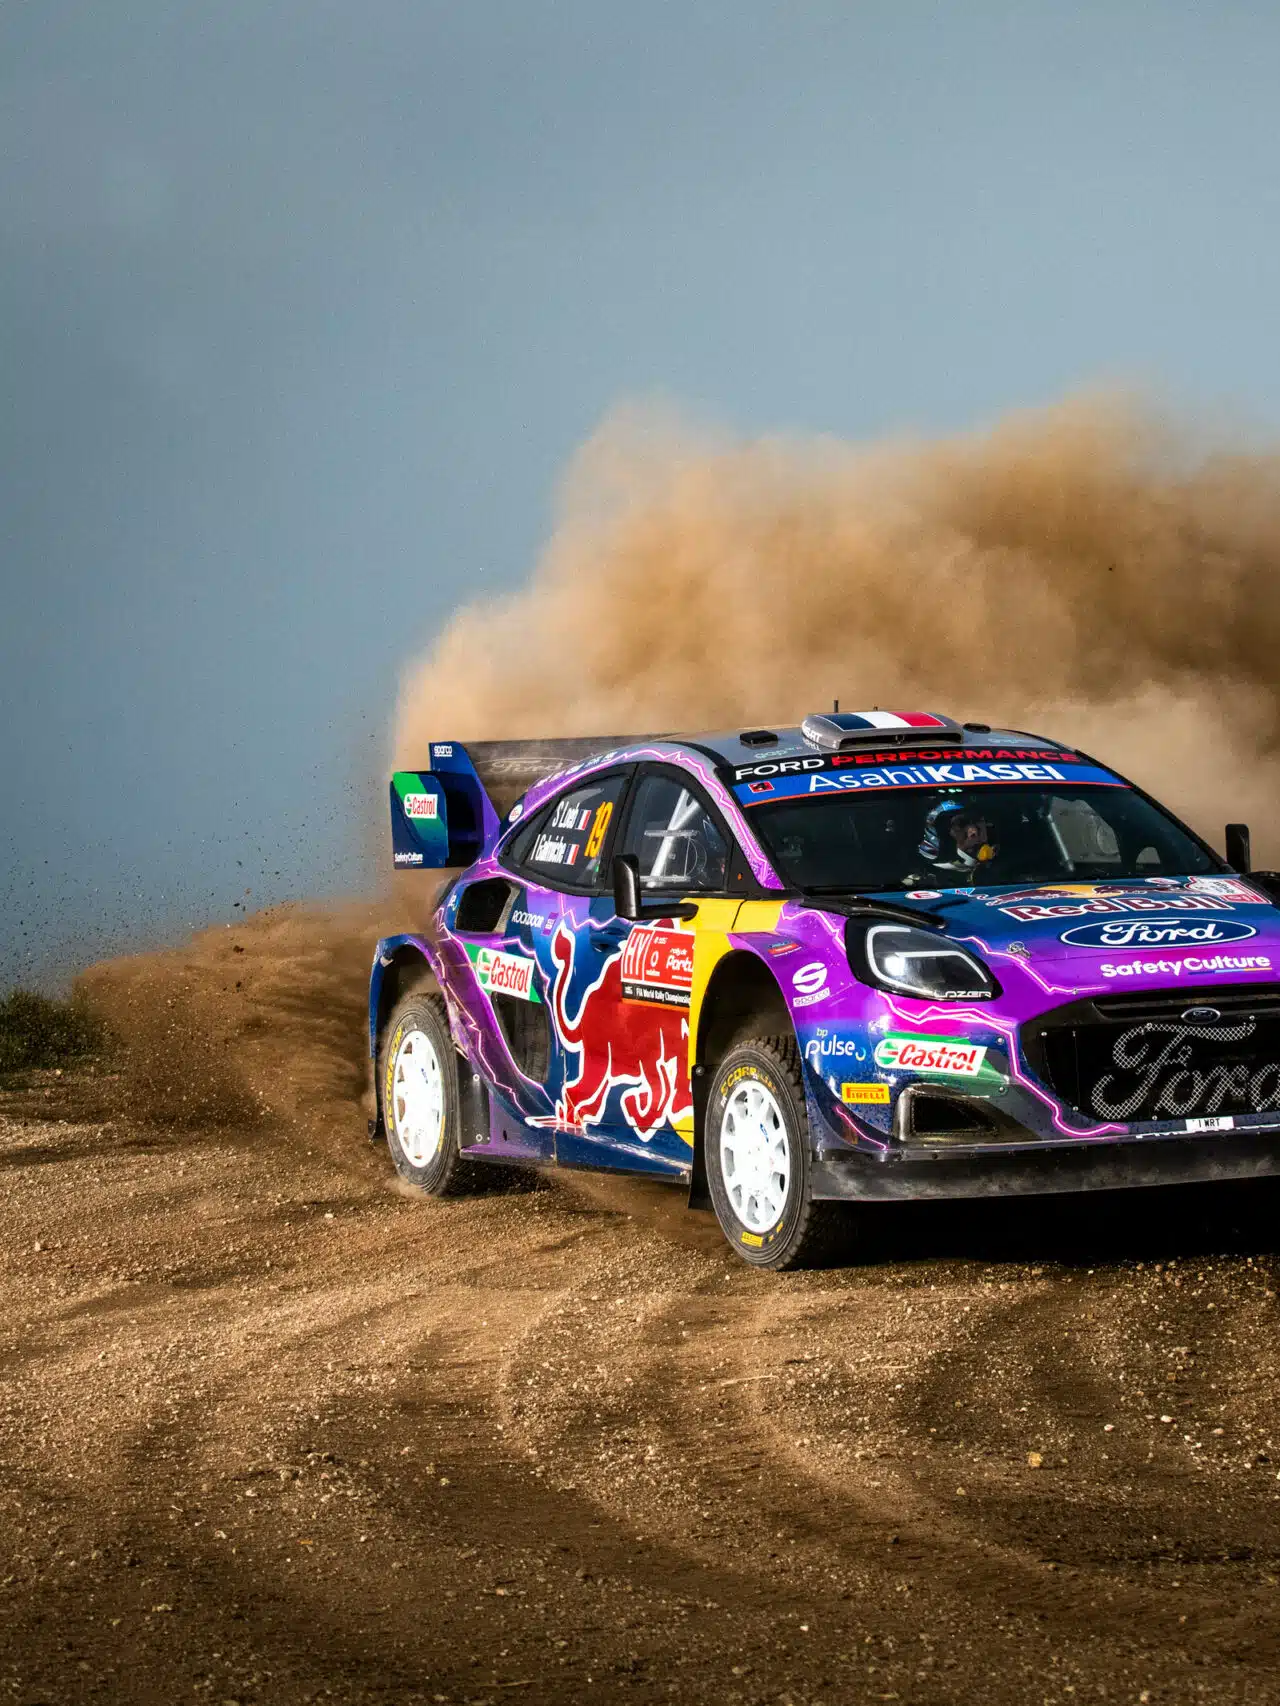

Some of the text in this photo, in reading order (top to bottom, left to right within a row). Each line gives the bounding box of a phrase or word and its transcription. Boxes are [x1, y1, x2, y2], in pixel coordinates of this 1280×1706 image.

[735, 749, 1081, 780] FORD PERFORMANCE
[411, 796, 436, 815] Castrol
[584, 801, 614, 858] 19
[999, 898, 1128, 921] Red
[1111, 896, 1236, 911] Bull
[1100, 920, 1224, 945] Ford
[491, 956, 530, 993] Castrol
[1100, 955, 1272, 977] SafetyCulture
[816, 1027, 828, 1038] bp
[805, 1034, 856, 1060] pulse
[899, 1043, 977, 1072] Castrol
[846, 1087, 886, 1100] PIRELLI
[1204, 1118, 1221, 1128] WRT
